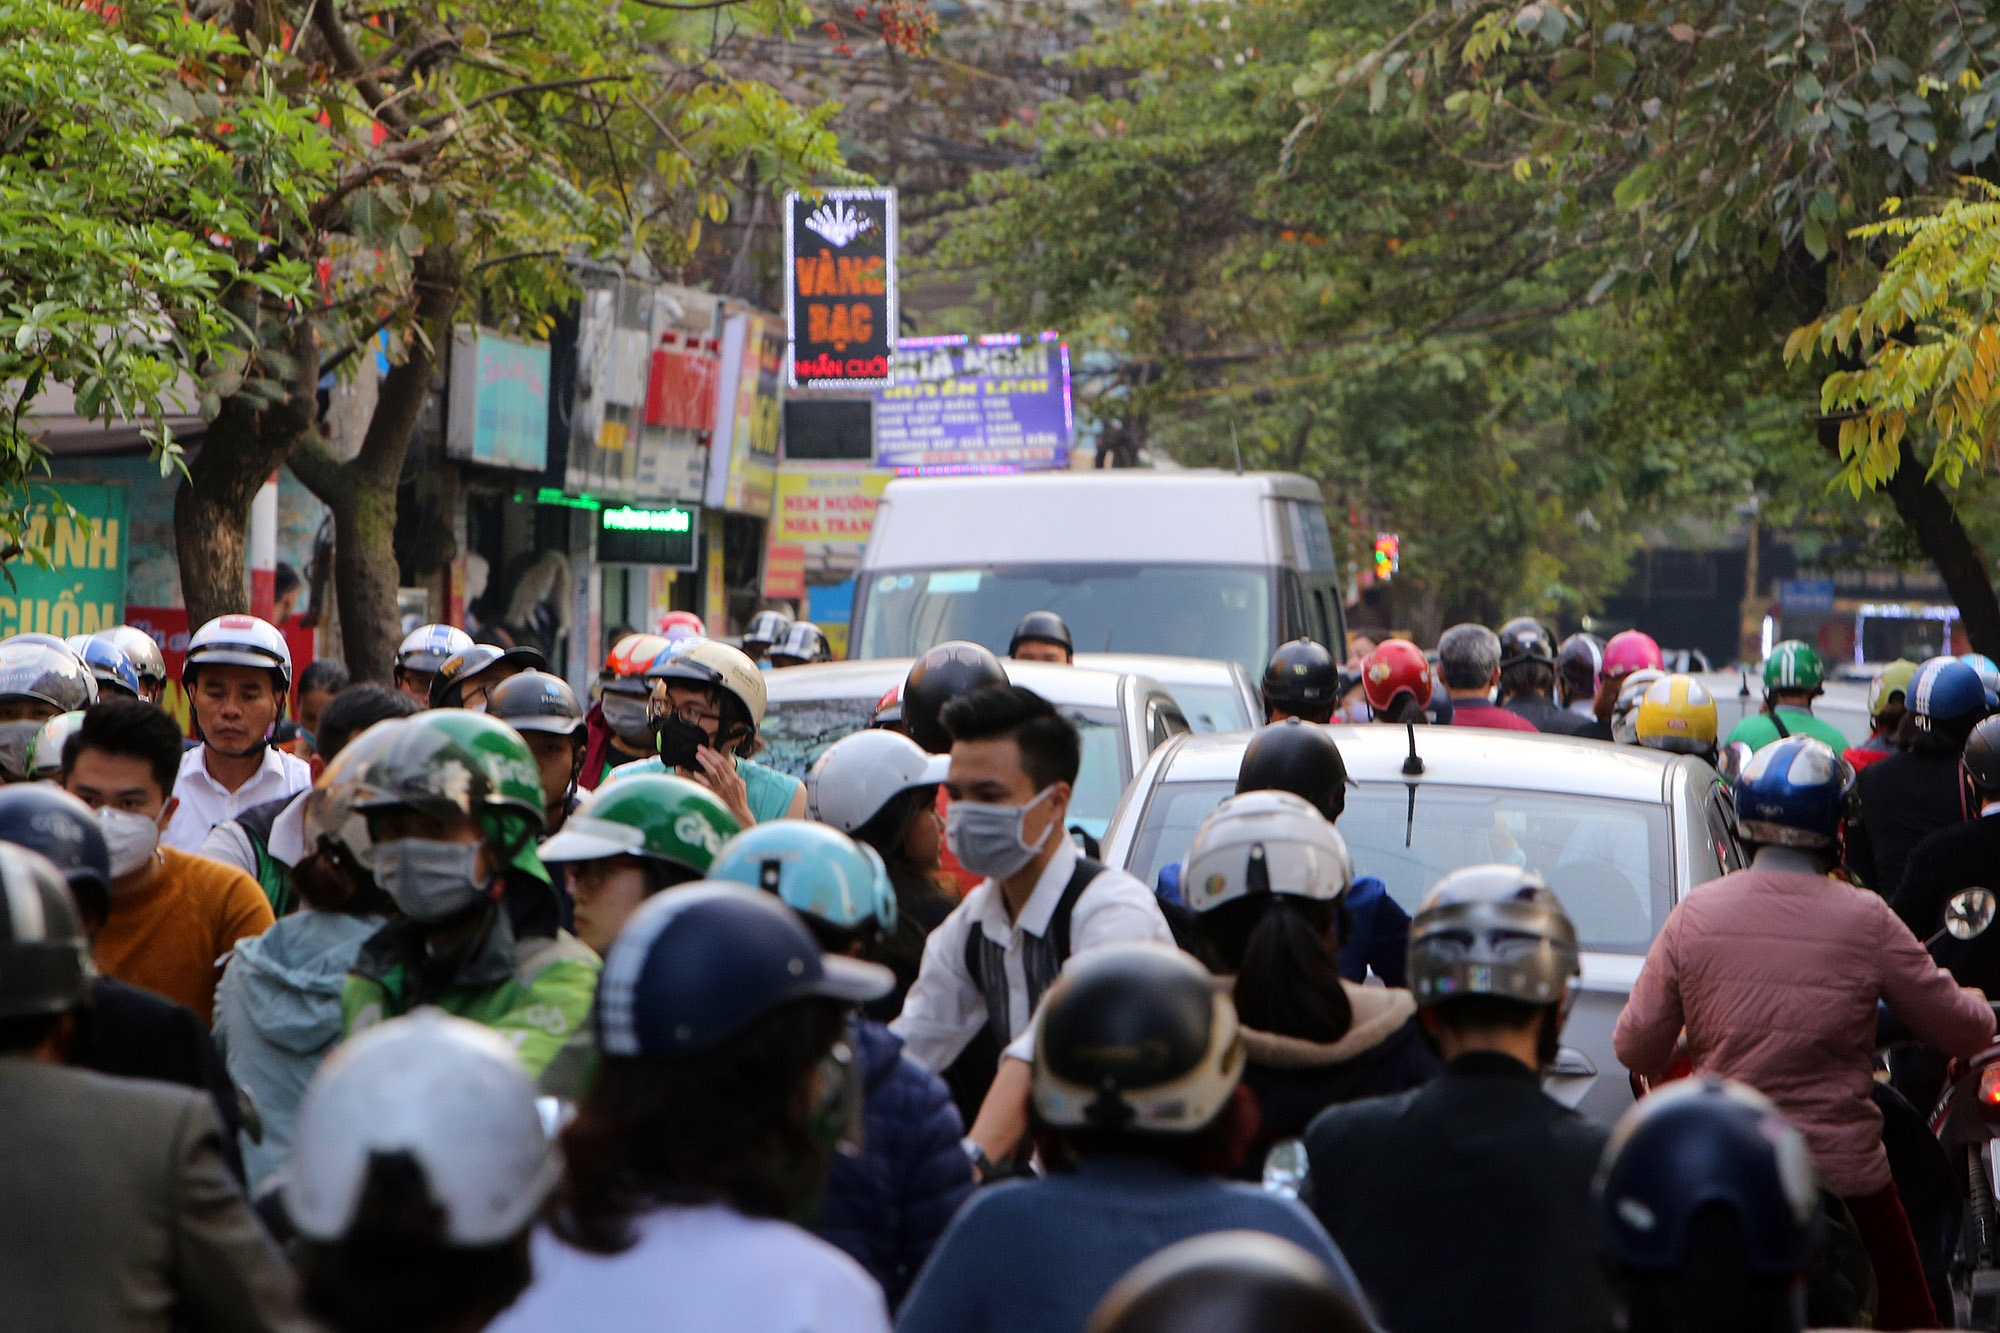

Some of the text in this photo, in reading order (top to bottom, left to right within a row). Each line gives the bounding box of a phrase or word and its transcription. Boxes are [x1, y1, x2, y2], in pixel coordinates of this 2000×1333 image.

[796, 248, 886, 296] VÀNG
[808, 302, 873, 351] BẠC
[825, 494, 880, 511] NƯỚN
[826, 517, 873, 533] TRAN
